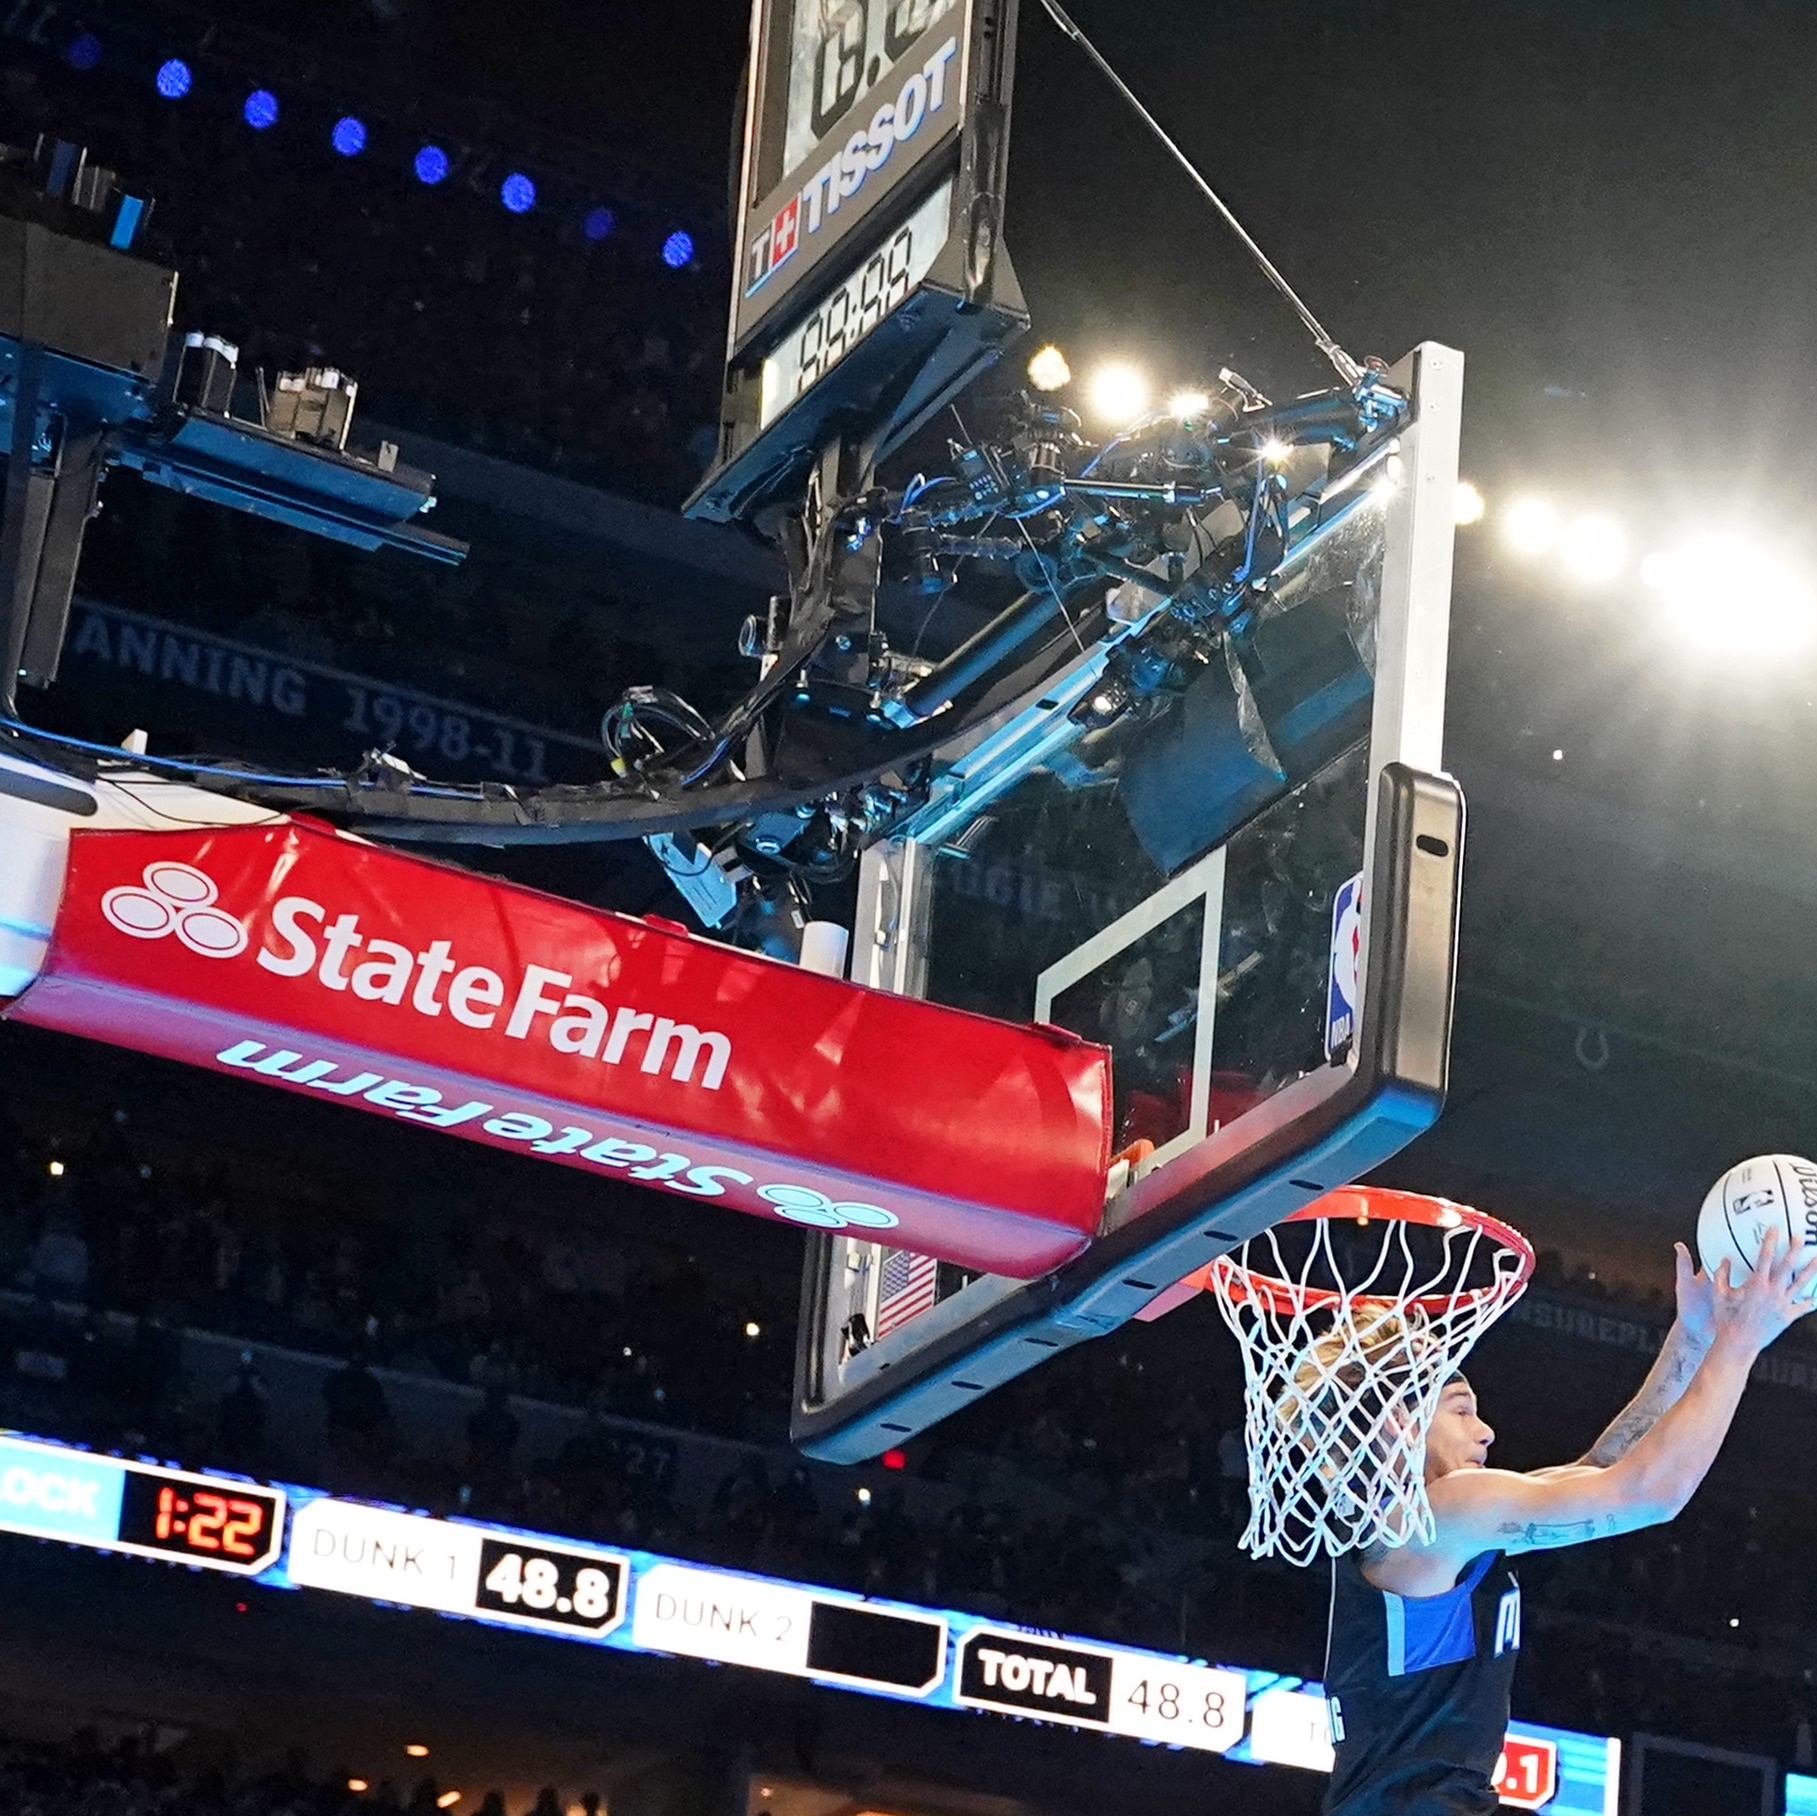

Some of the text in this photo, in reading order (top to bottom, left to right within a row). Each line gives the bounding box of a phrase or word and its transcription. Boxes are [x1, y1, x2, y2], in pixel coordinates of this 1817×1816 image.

[802, 36, 957, 234] TISSOT
[343, 685, 549, 783] 1998-11
[155, 1486, 263, 1557] 1:22
[312, 1527, 458, 1581] DUNK 1
[484, 1552, 611, 1619] 48.8
[654, 1592, 794, 1643] DUNK 2
[977, 1647, 1225, 1729] TOTAL 48.8
